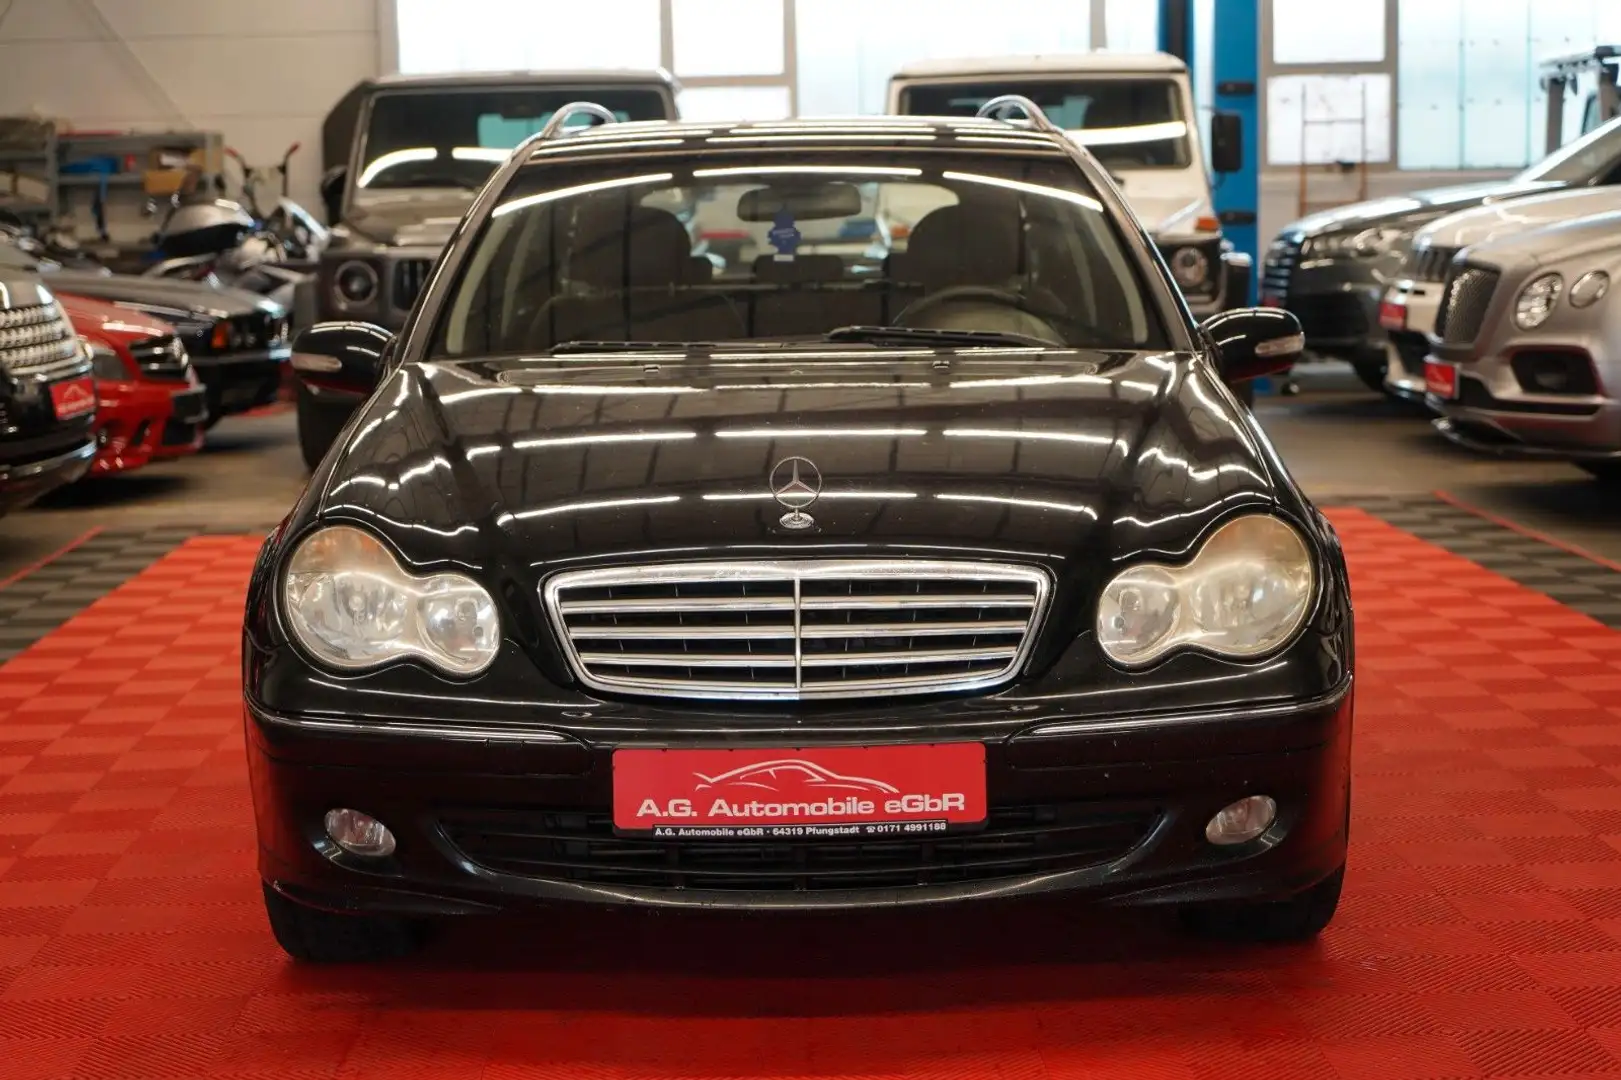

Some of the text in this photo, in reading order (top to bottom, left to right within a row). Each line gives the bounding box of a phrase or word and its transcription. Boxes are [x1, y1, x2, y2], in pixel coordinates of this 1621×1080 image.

[636, 793, 965, 817] A.G. Automobile eGbR
[655, 827, 676, 836] A.G.
[678, 827, 734, 836] Automobile
[737, 827, 764, 836] eGbR
[772, 827, 803, 835] 64319
[805, 826, 859, 835] Pfungstadt
[878, 824, 900, 832] 0171
